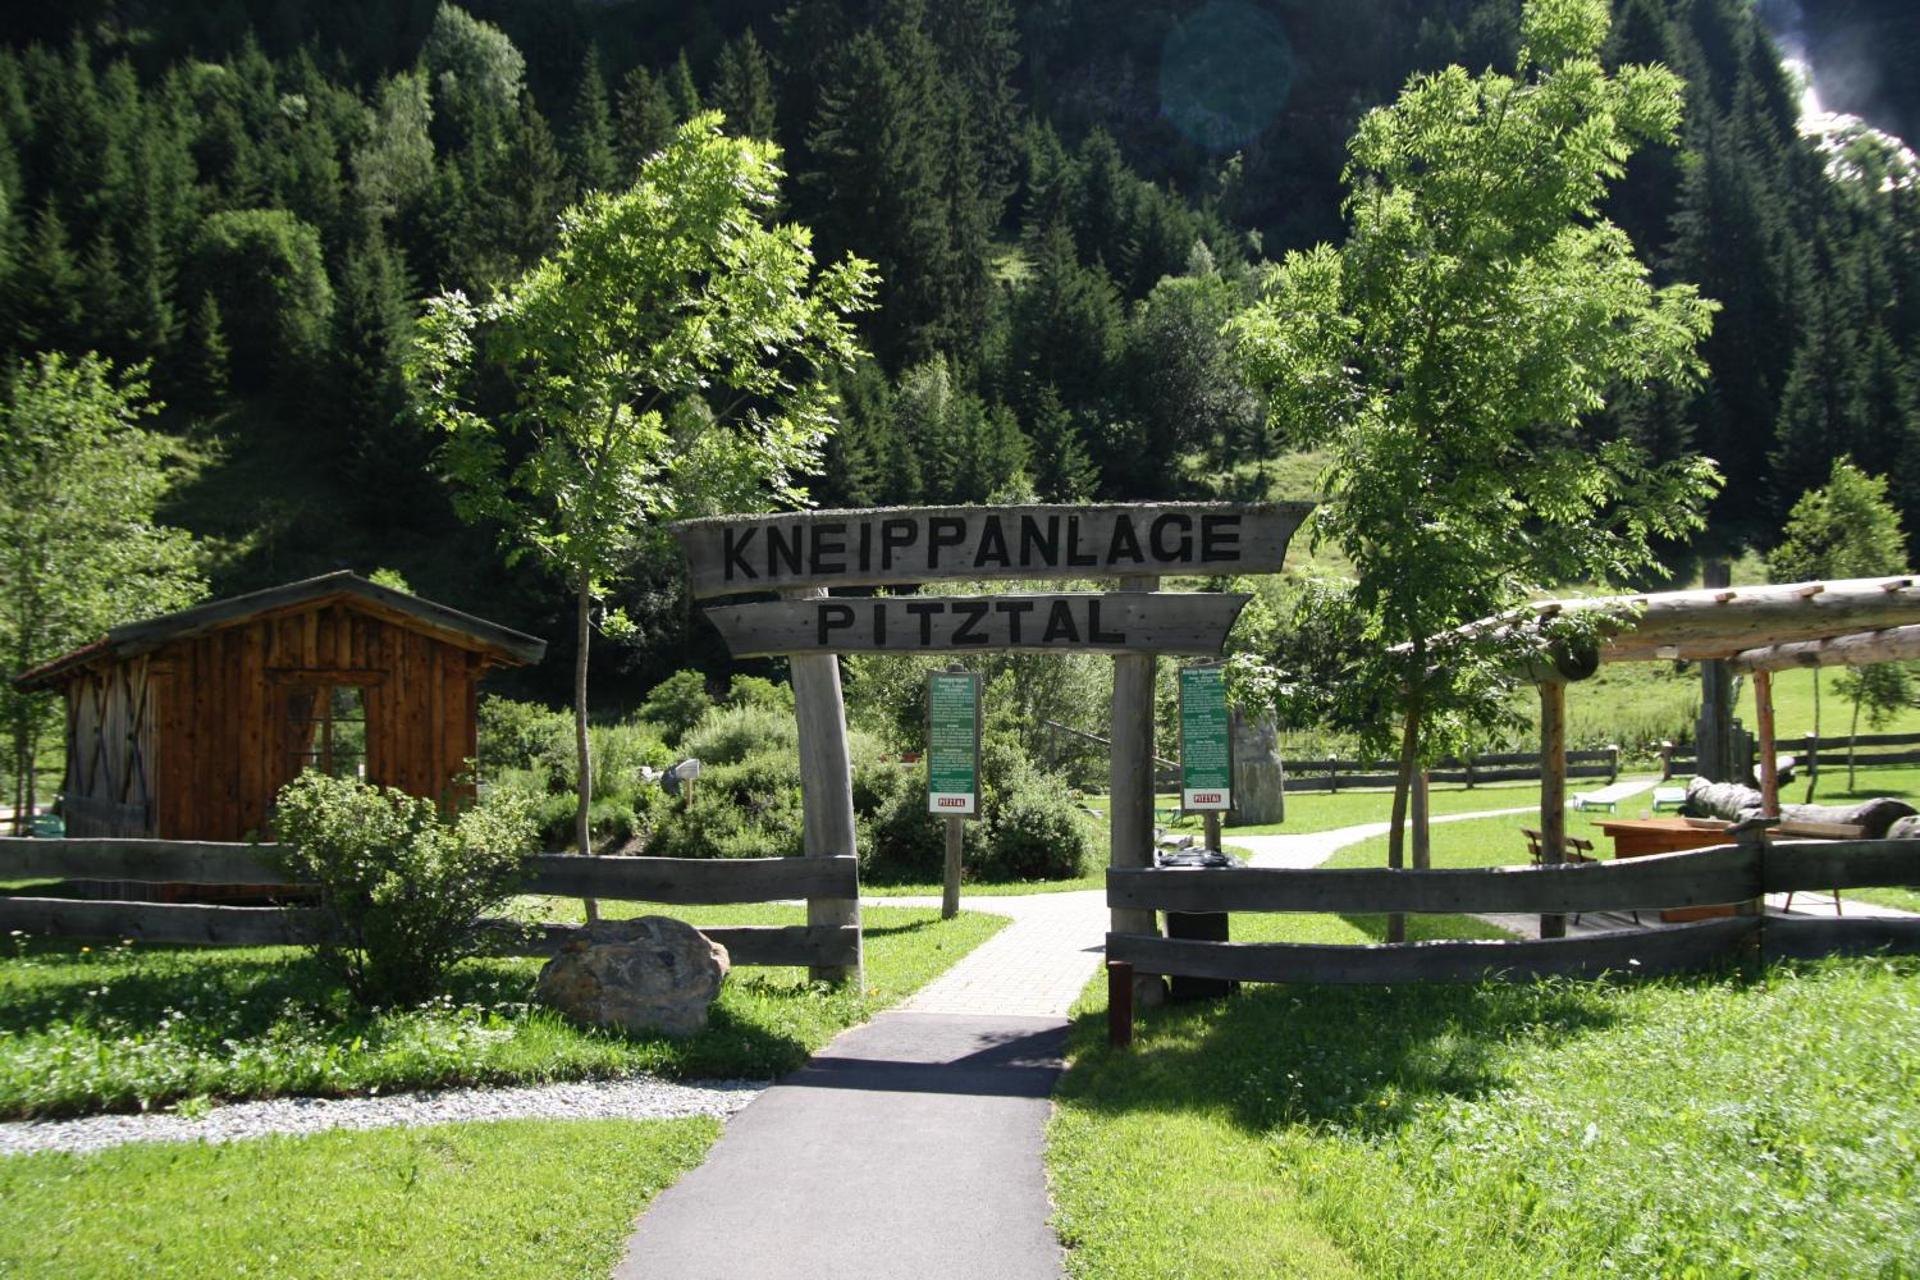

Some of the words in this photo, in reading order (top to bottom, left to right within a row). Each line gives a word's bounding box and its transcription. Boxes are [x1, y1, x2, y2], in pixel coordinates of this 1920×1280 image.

[724, 514, 1241, 580] KNEIPPANLAGE
[818, 600, 1126, 645] PITZTAL
[938, 798, 966, 807] PITZTAL
[1194, 794, 1221, 803] PITZTAL
